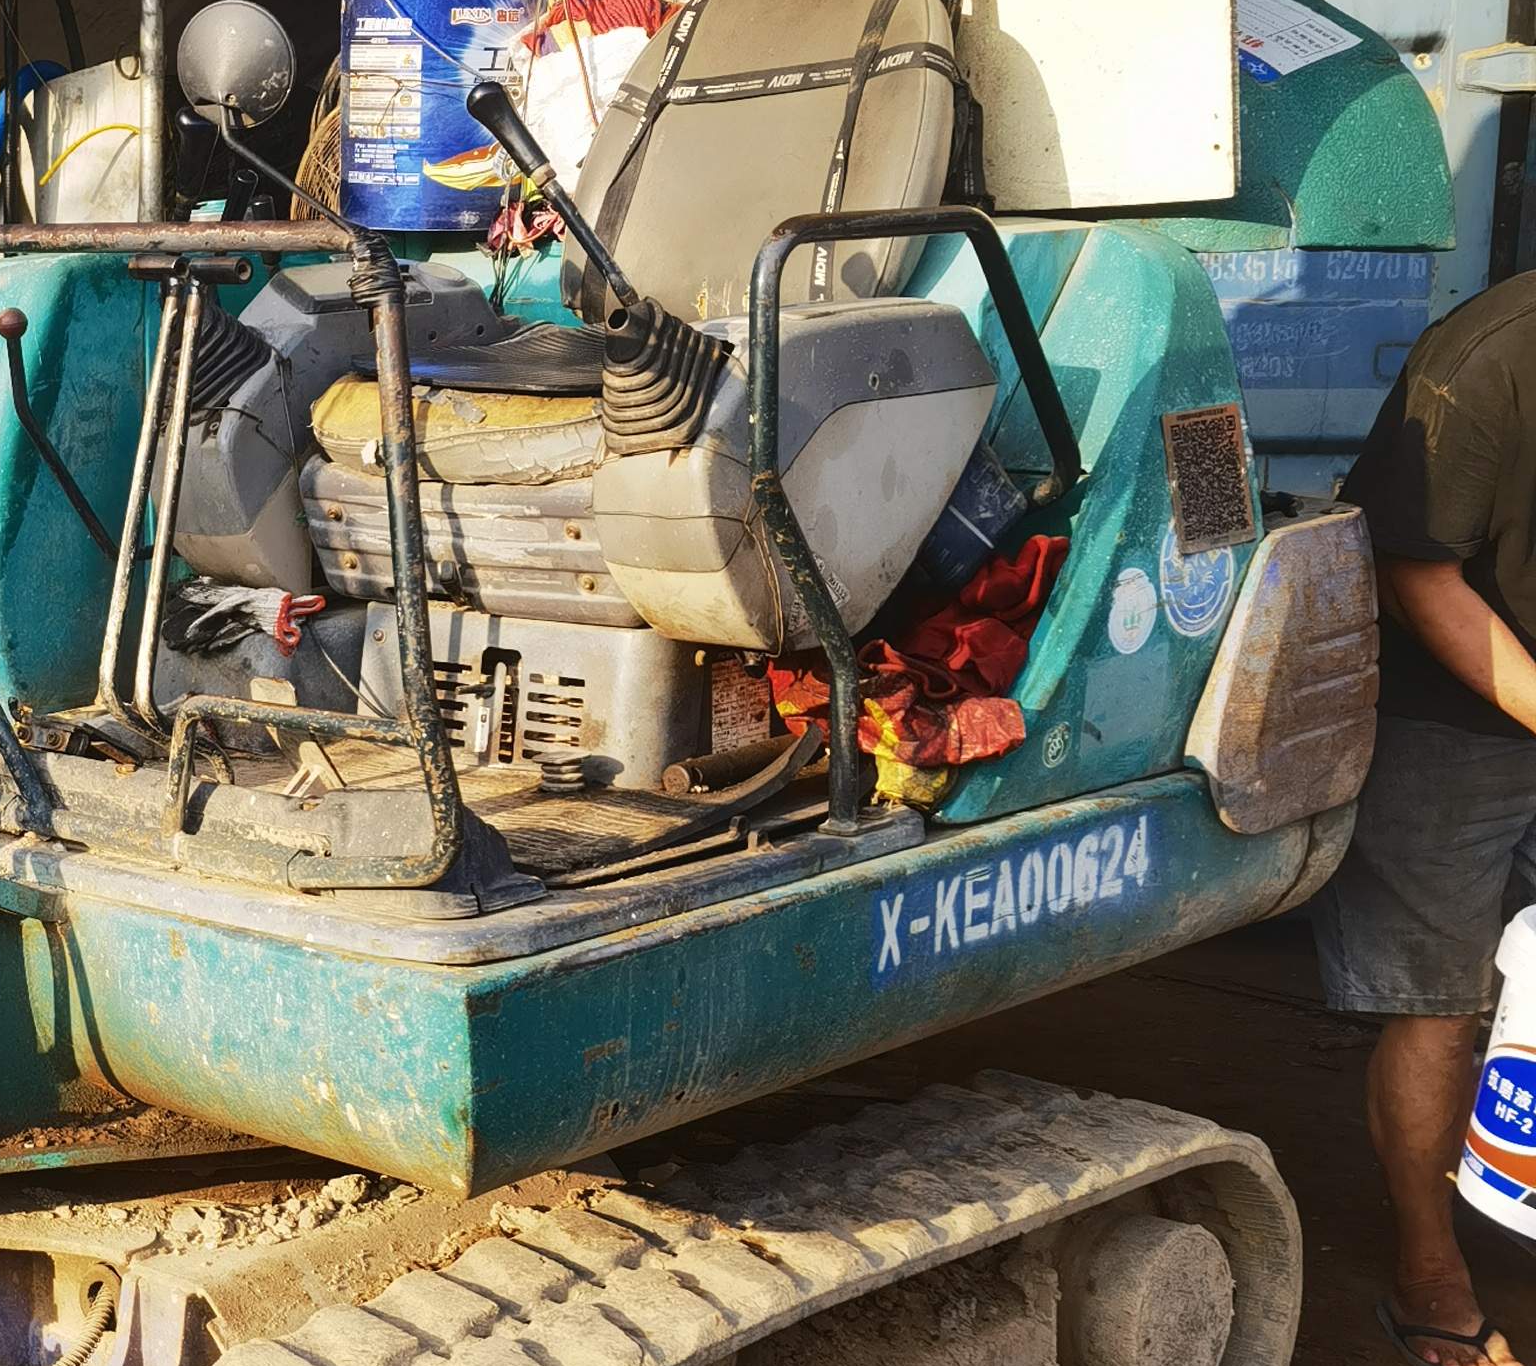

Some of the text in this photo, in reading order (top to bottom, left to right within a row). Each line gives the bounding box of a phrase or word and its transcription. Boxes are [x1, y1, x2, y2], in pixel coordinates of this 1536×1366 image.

[674, 10, 697, 43] MDIV
[876, 51, 914, 72] MDIV
[767, 72, 805, 89] MDIV
[814, 246, 828, 286] MDIV
[877, 815, 1149, 973] X-KEA00624
[1495, 1099, 1533, 1135] HF-2
